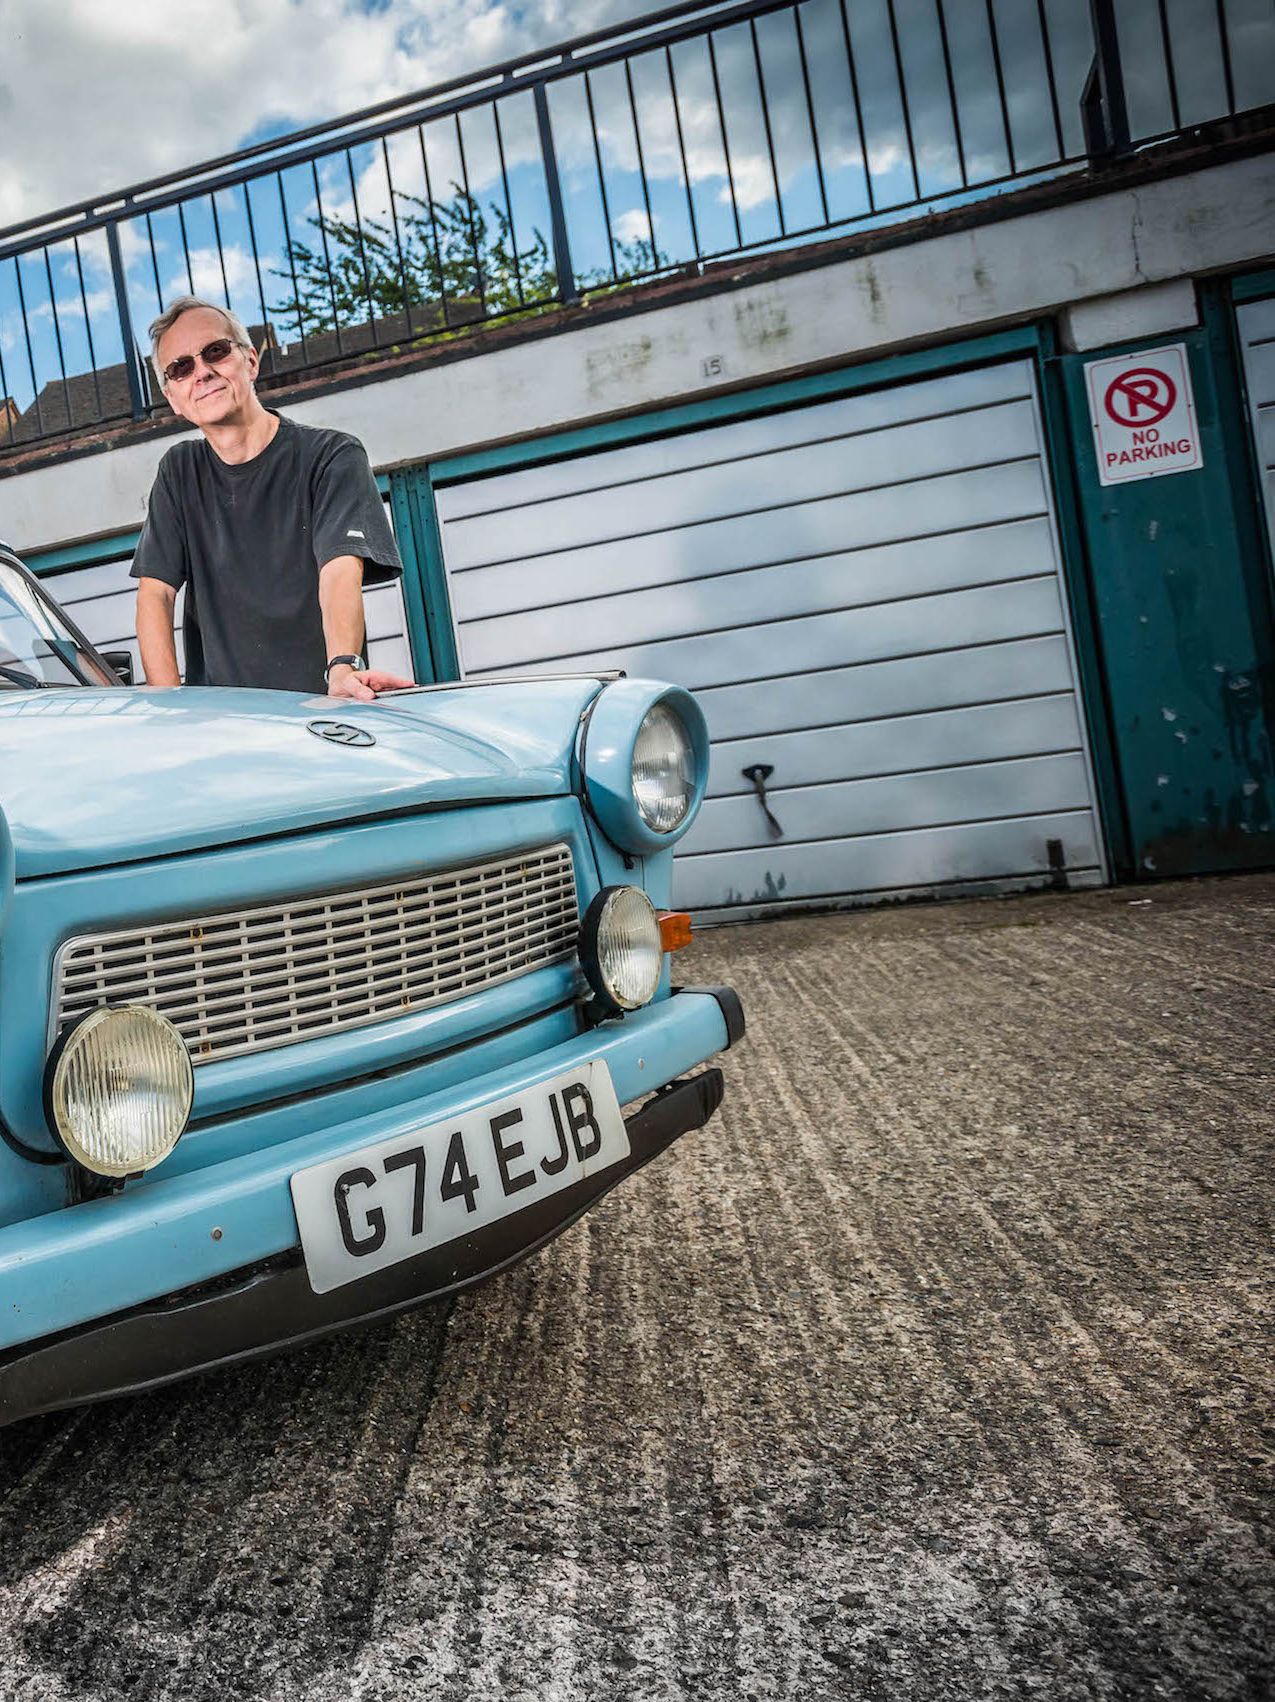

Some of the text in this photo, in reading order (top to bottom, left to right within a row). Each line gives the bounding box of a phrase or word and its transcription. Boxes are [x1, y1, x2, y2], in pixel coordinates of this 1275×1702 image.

[1132, 428, 1160, 446] NO
[1106, 439, 1191, 467] PARKING
[334, 1082, 602, 1257] G74 EJB
